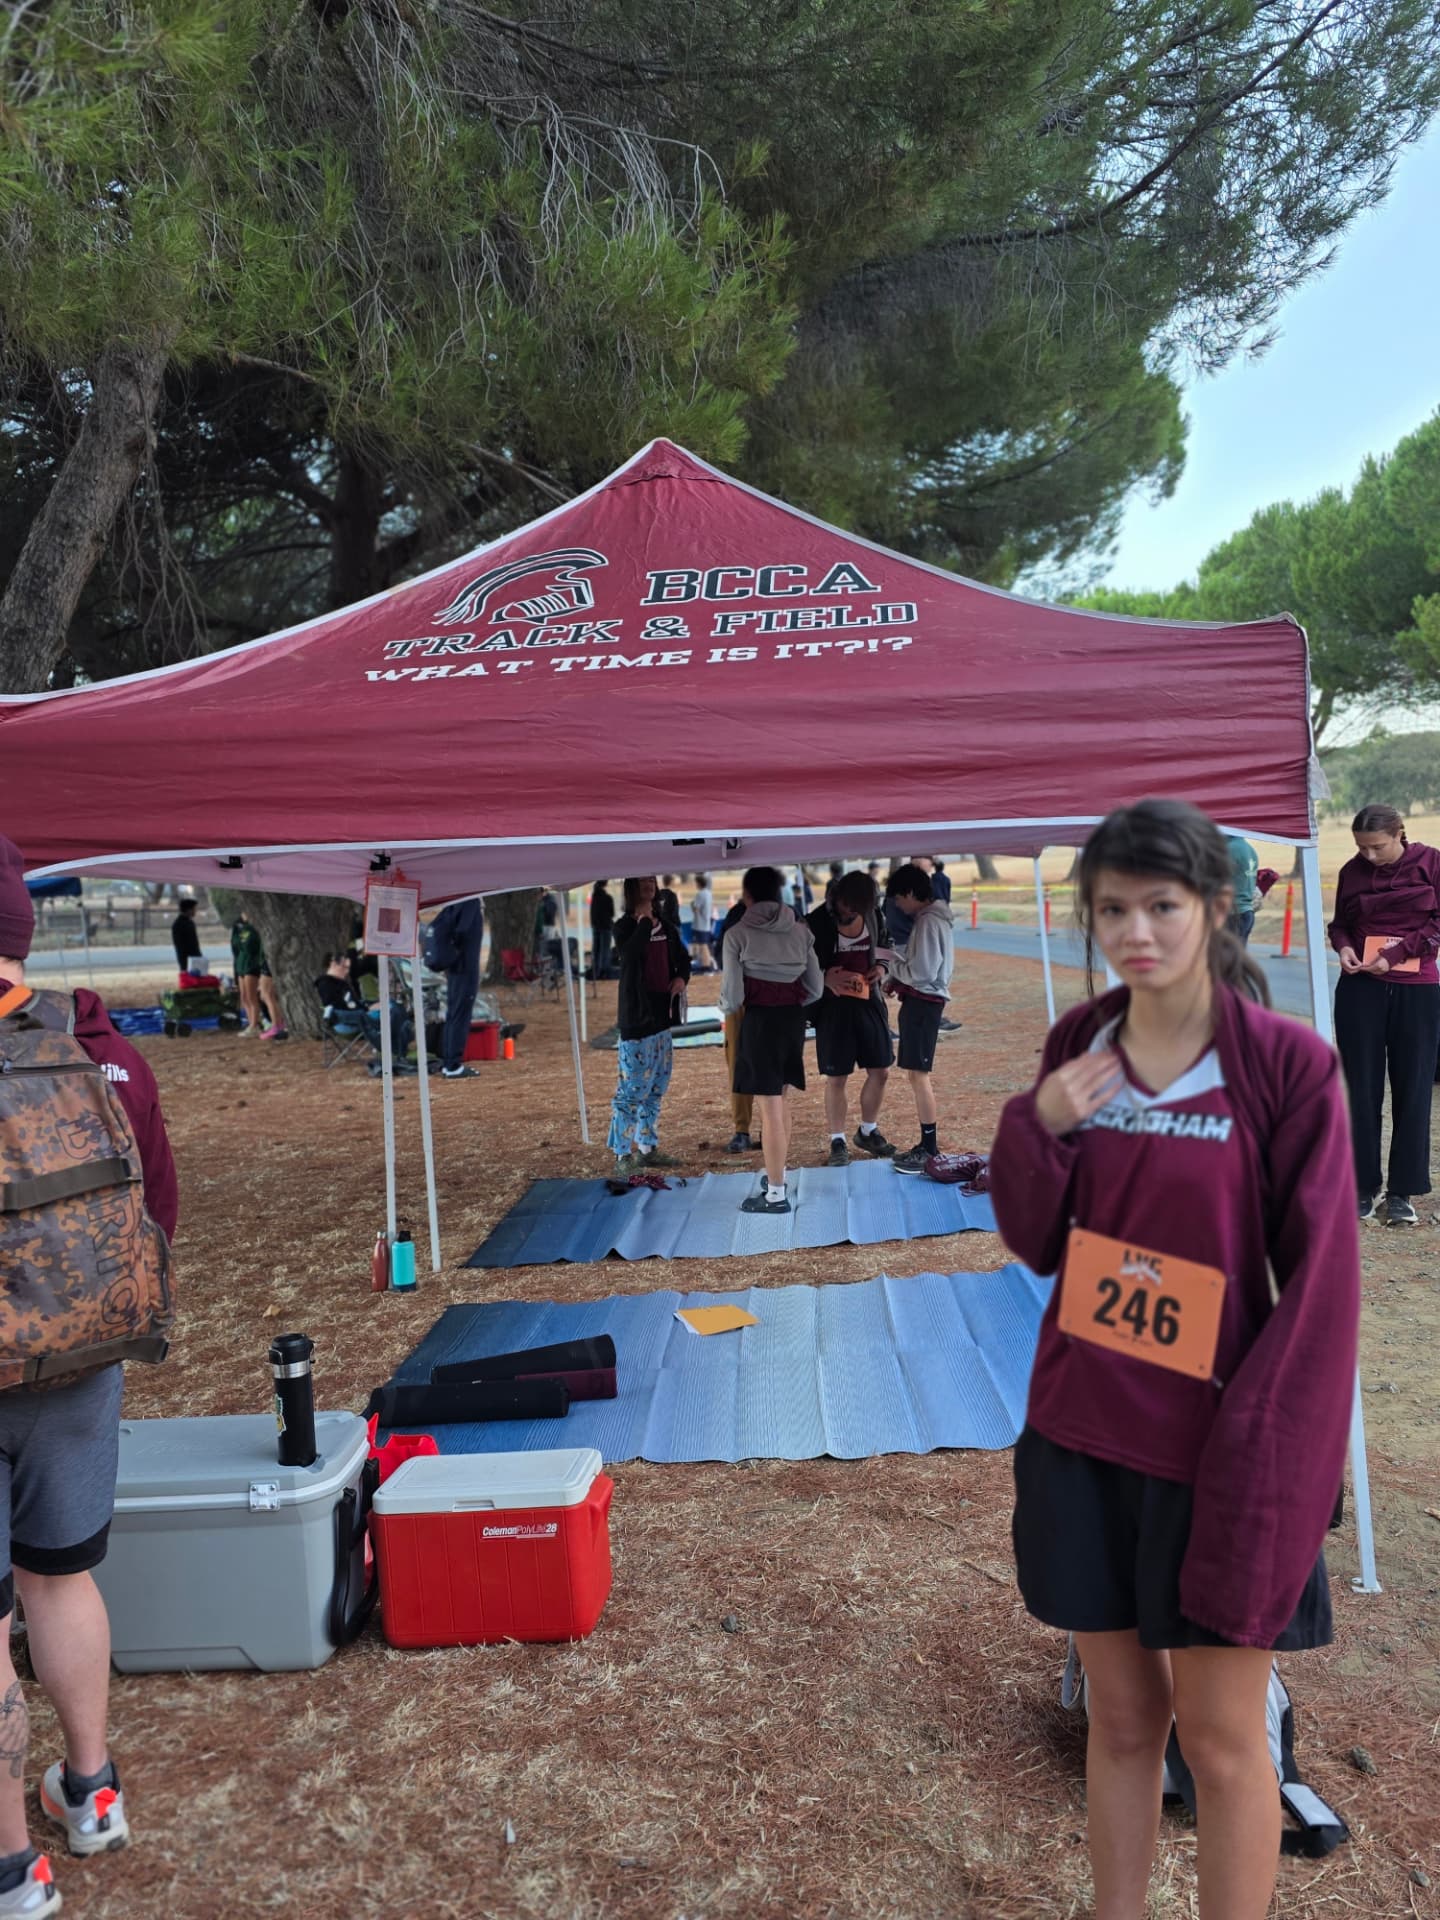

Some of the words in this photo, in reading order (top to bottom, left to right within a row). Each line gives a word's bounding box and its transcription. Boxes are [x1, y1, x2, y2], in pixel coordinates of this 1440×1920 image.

[640, 562, 881, 606] BCCA
[383, 619, 623, 660] TRACK
[640, 616, 690, 640] &
[710, 602, 918, 637] FIELD
[365, 662, 534, 682] WHAT
[550, 650, 692, 672] TIME
[706, 647, 758, 663] IS
[1093, 1277, 1182, 1346] 246
